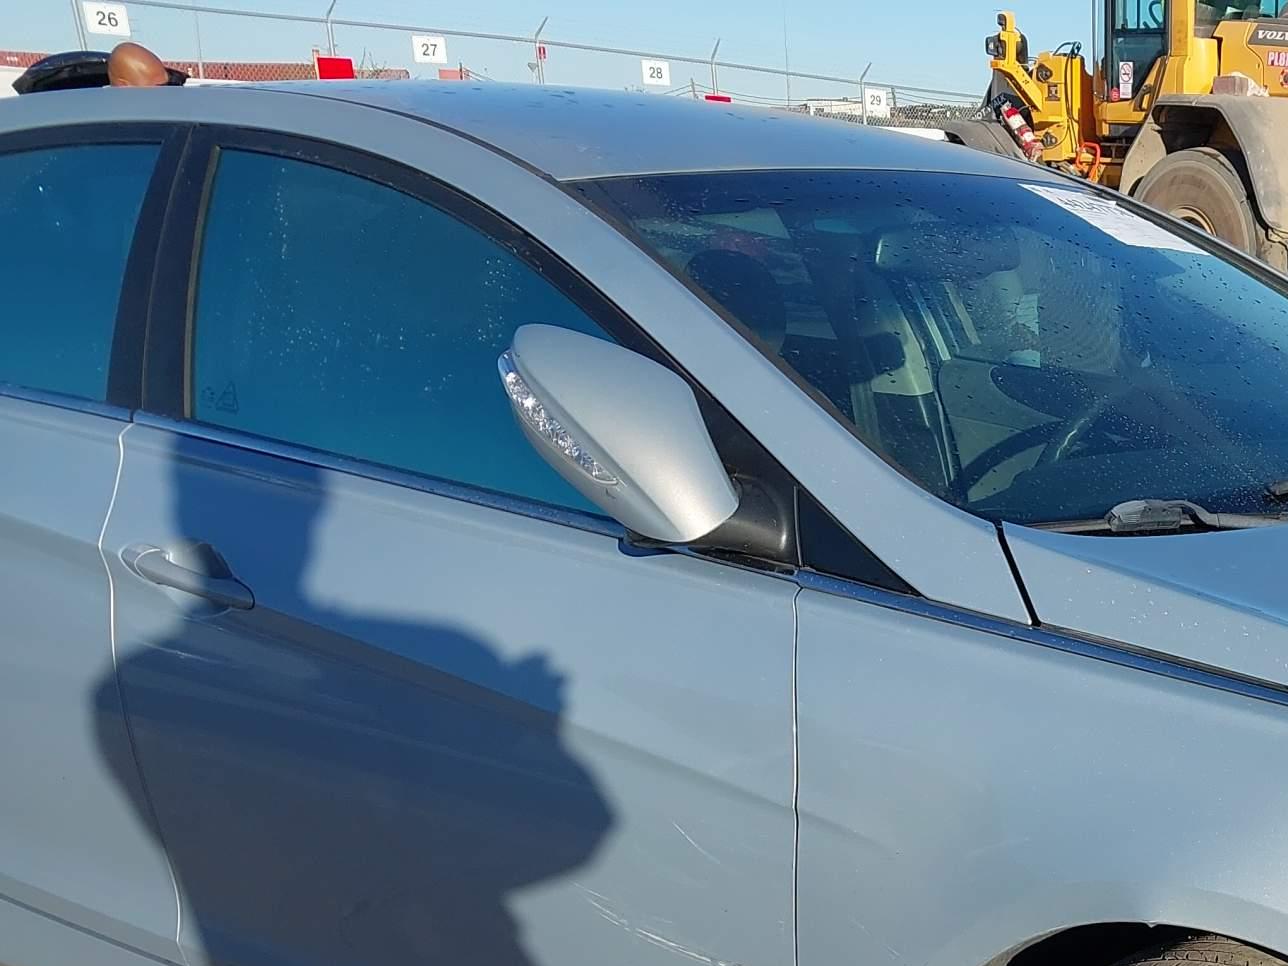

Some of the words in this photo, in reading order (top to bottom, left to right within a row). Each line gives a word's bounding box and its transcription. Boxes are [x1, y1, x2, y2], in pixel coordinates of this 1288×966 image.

[95, 10, 119, 27] 26
[421, 43, 438, 56] 27
[648, 66, 663, 79] 28
[870, 94, 882, 106] 29
